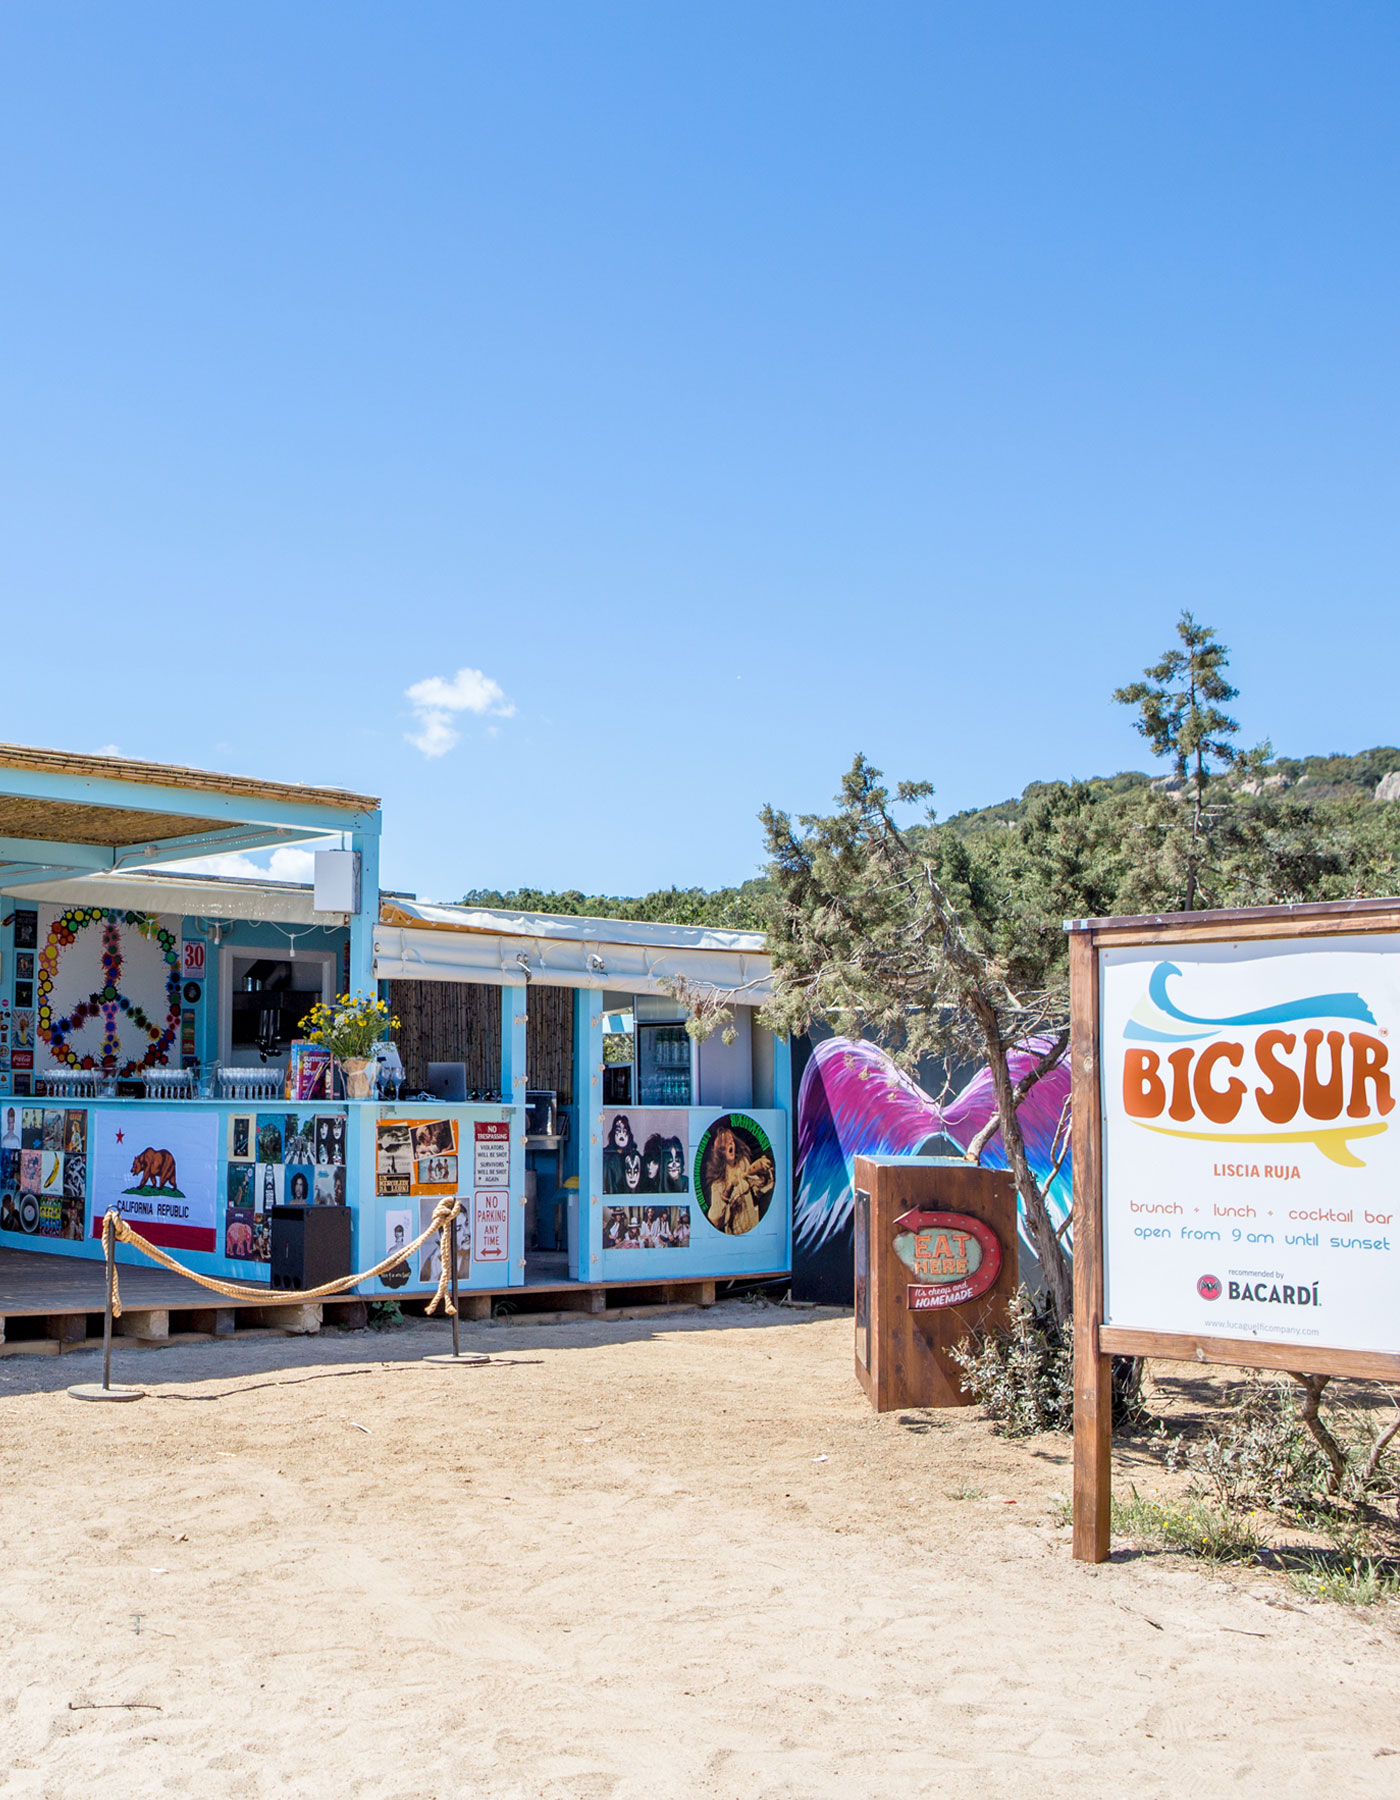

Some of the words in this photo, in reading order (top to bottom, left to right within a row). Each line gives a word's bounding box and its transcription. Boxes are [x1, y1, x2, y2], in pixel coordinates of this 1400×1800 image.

[185, 944, 204, 967] 30
[1123, 1041, 1248, 1124] BIG
[1254, 1028, 1396, 1124] SUR
[487, 1125, 498, 1134] NO
[1214, 1164, 1261, 1178] LISCIA
[1264, 1165, 1301, 1180] RUJA
[117, 1200, 154, 1215] CALIFORNIA
[156, 1203, 190, 1218] REPUBLIC
[486, 1196, 498, 1208] NO
[478, 1210, 506, 1222] PARKING
[1130, 1200, 1184, 1215] brunch
[1214, 1203, 1256, 1218] lunch
[1288, 1208, 1353, 1223] cocktail
[1364, 1210, 1394, 1224] bar
[484, 1225, 500, 1234] ANY
[484, 1236, 500, 1246] TIME
[914, 1234, 972, 1258] EAT
[1134, 1227, 1172, 1240] open
[1181, 1226, 1221, 1241] from
[1285, 1232, 1319, 1246] until
[1330, 1236, 1391, 1251] sunset
[914, 1258, 969, 1275] HERE
[1228, 1269, 1275, 1278] recommended
[1276, 1270, 1284, 1279] by
[915, 1288, 927, 1296] It's
[928, 1286, 952, 1296] cheap
[952, 1280, 969, 1292] and
[915, 1288, 974, 1308] HOMEMADE
[1204, 1320, 1320, 1336] www.lucaguelficompany.com
